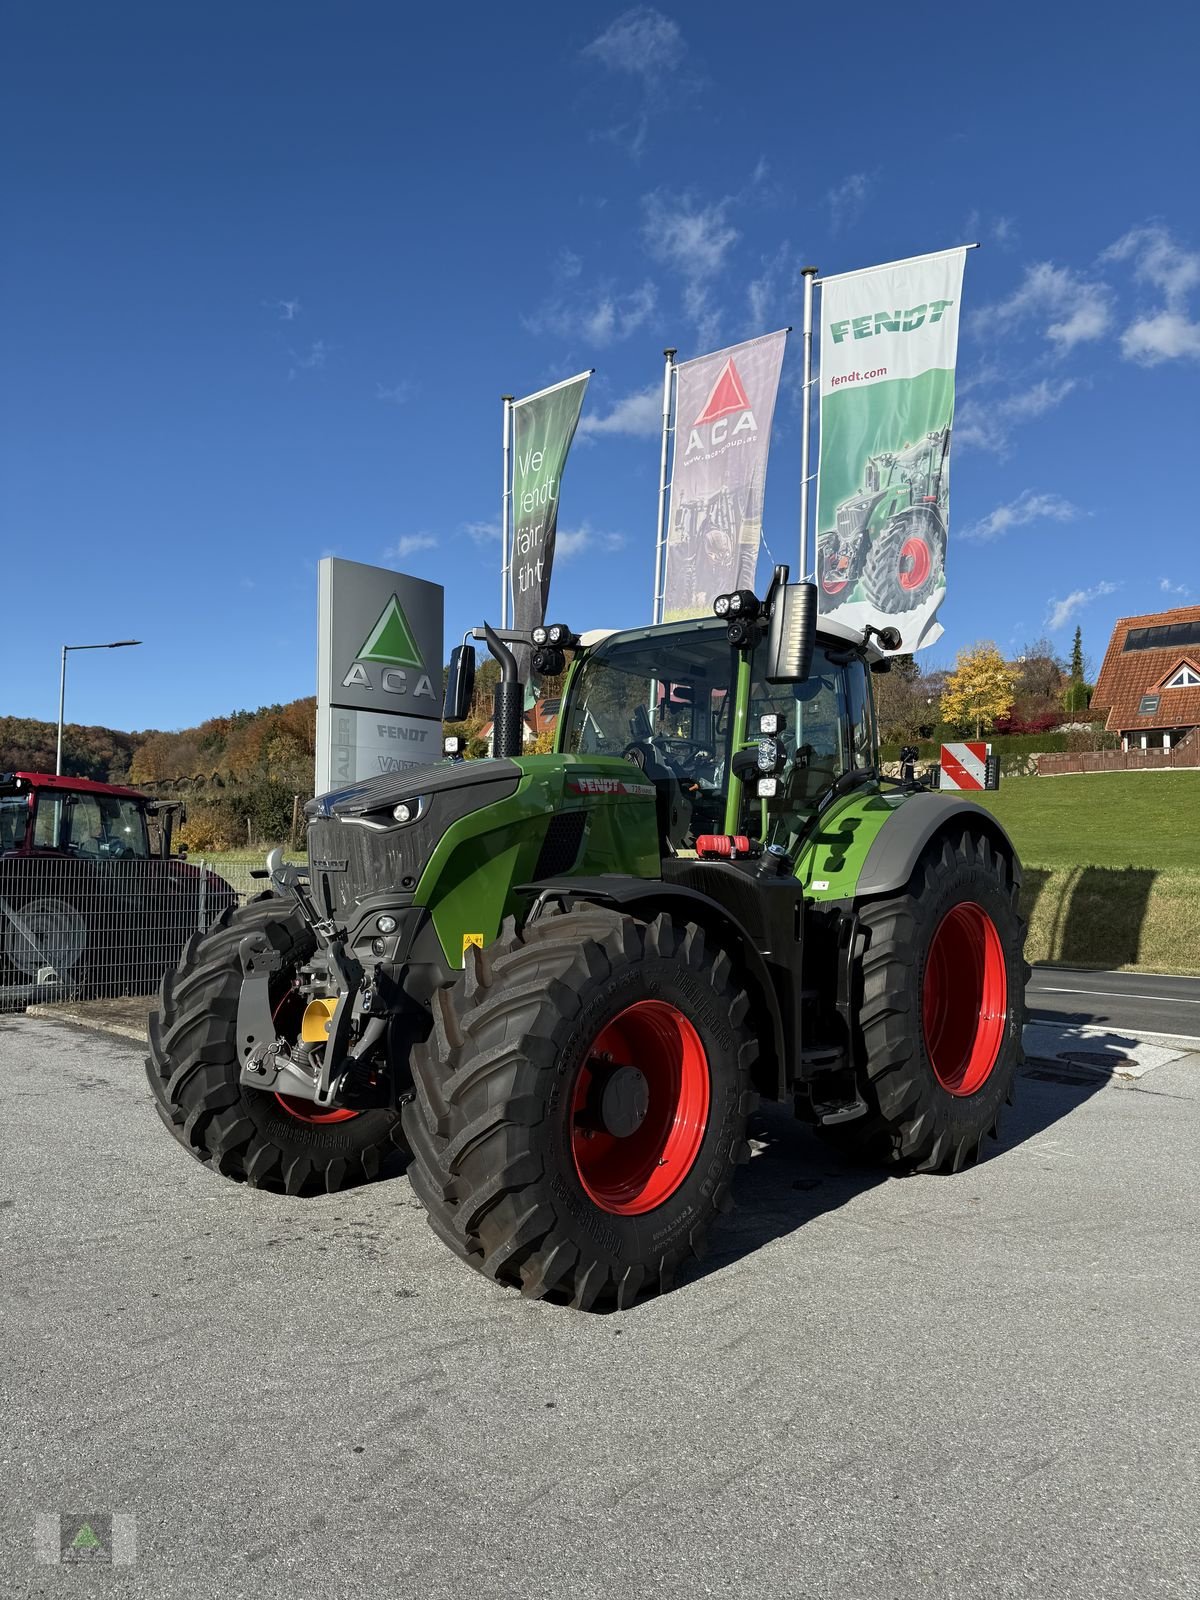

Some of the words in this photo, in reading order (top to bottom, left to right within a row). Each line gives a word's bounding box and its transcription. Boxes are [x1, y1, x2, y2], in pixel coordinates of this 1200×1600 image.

[830, 300, 954, 344] FENDT
[831, 366, 888, 387] fendt.com
[684, 410, 758, 456] ACA
[341, 661, 437, 701] ACA
[376, 724, 428, 742] FENDT
[577, 778, 620, 792] FENDT
